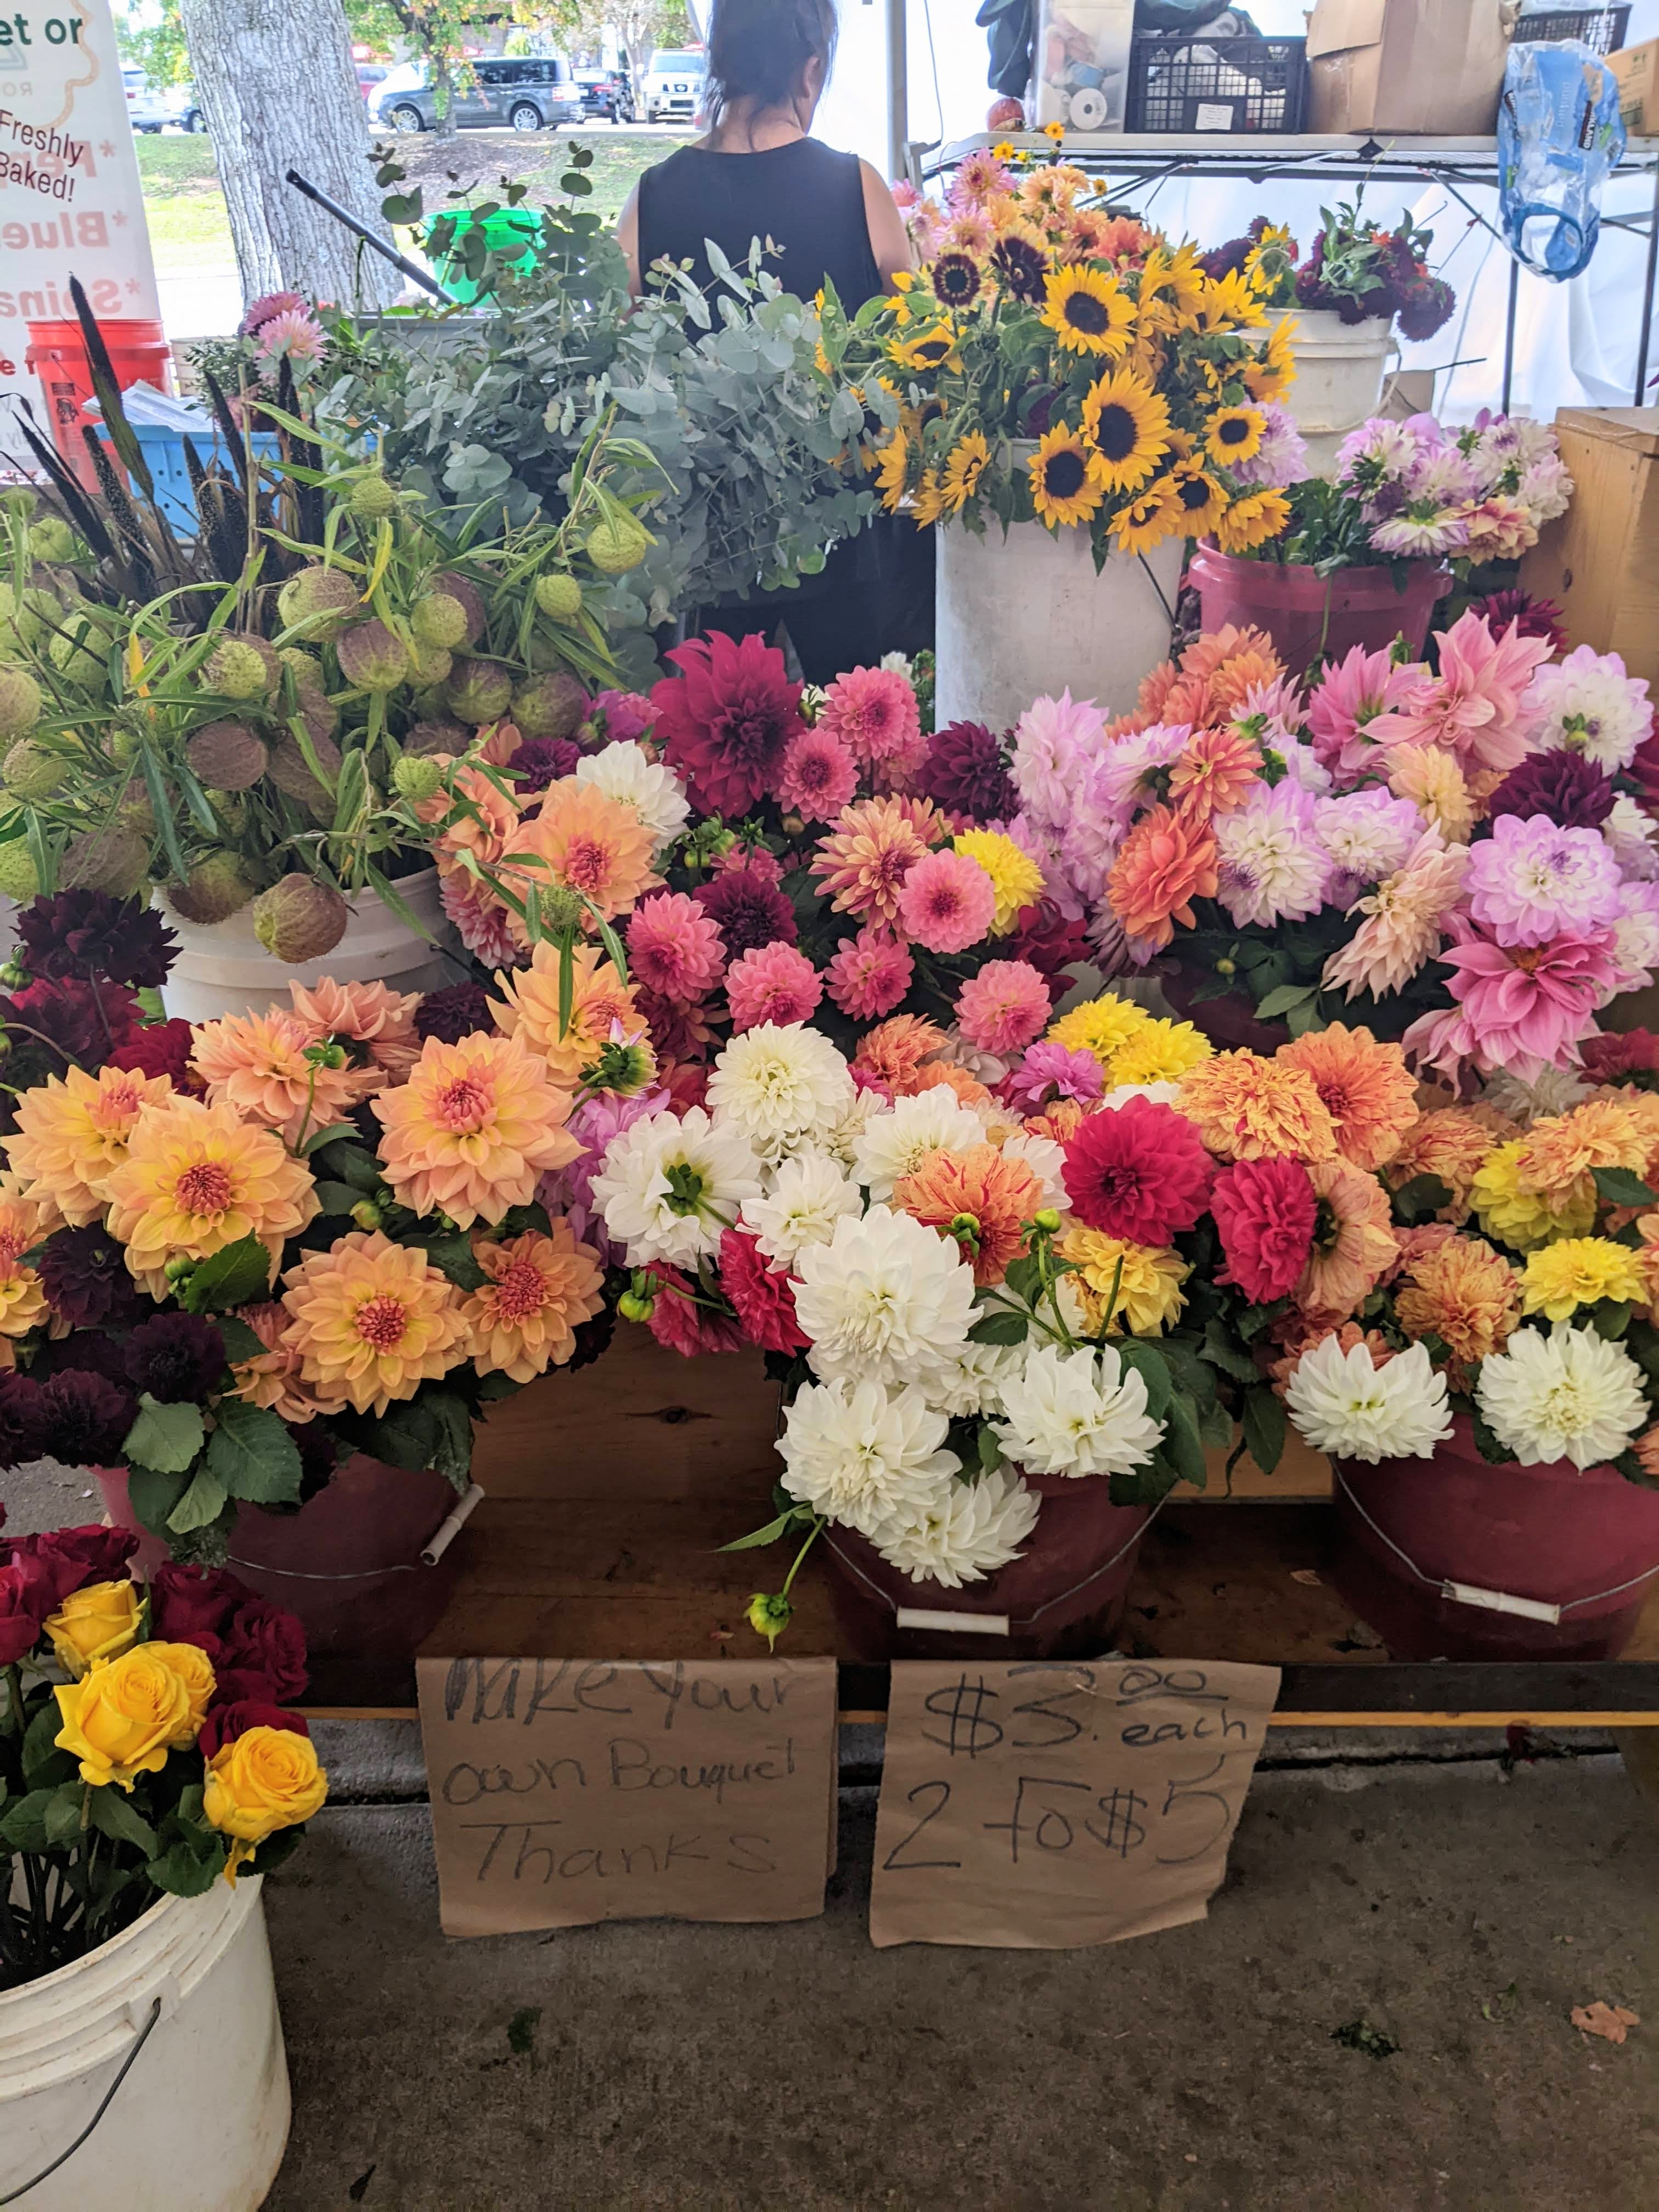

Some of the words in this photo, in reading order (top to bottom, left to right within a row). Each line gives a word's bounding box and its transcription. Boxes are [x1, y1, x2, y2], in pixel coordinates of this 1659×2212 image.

[44, 18, 83, 44] or
[0, 109, 83, 168] Freshly
[0, 151, 75, 202] Baked!
[1120, 1708, 1247, 1746] each
[607, 1737, 808, 1804] Bouquet
[883, 1781, 961, 1870] 2
